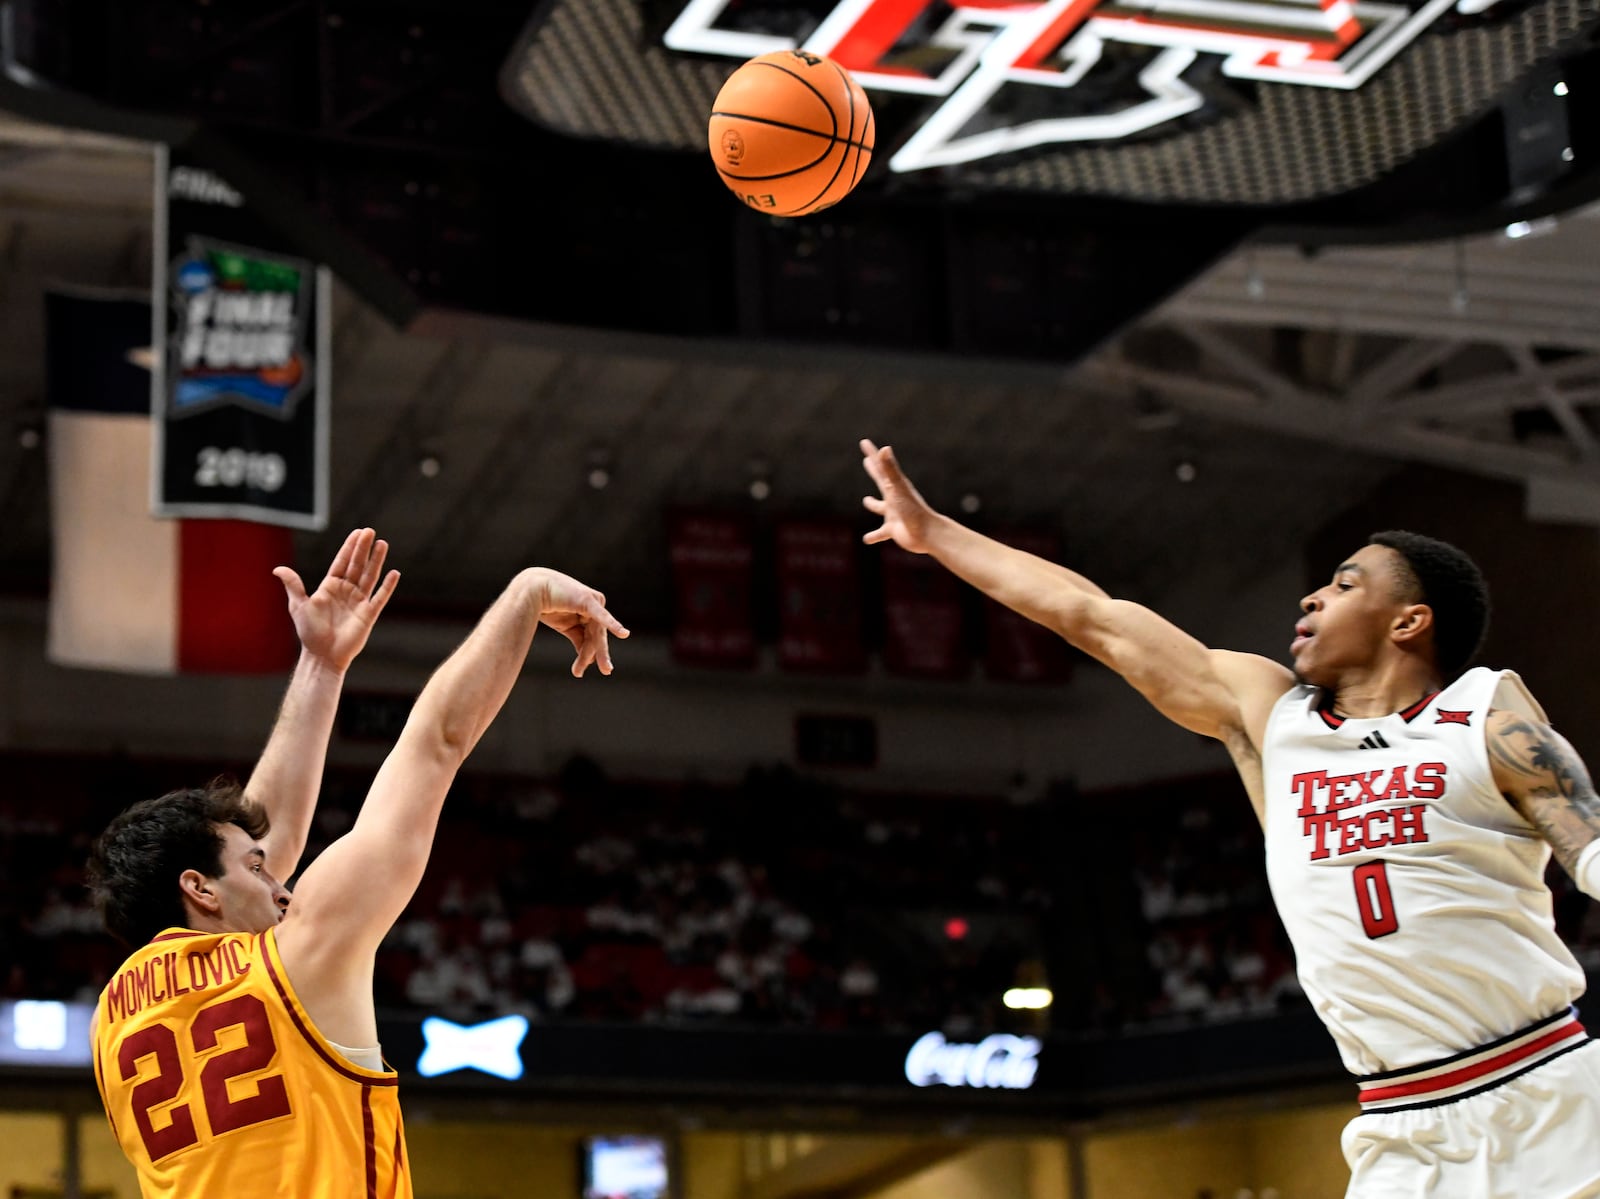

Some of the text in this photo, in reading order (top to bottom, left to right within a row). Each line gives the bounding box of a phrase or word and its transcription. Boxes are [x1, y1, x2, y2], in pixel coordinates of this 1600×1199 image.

[195, 446, 286, 492] 2019
[1291, 762, 1447, 818] TEXAS
[1303, 804, 1429, 861] TECH
[1352, 858, 1399, 940] 0
[107, 938, 251, 1023] MOMCILOVIC
[117, 993, 292, 1163] 22
